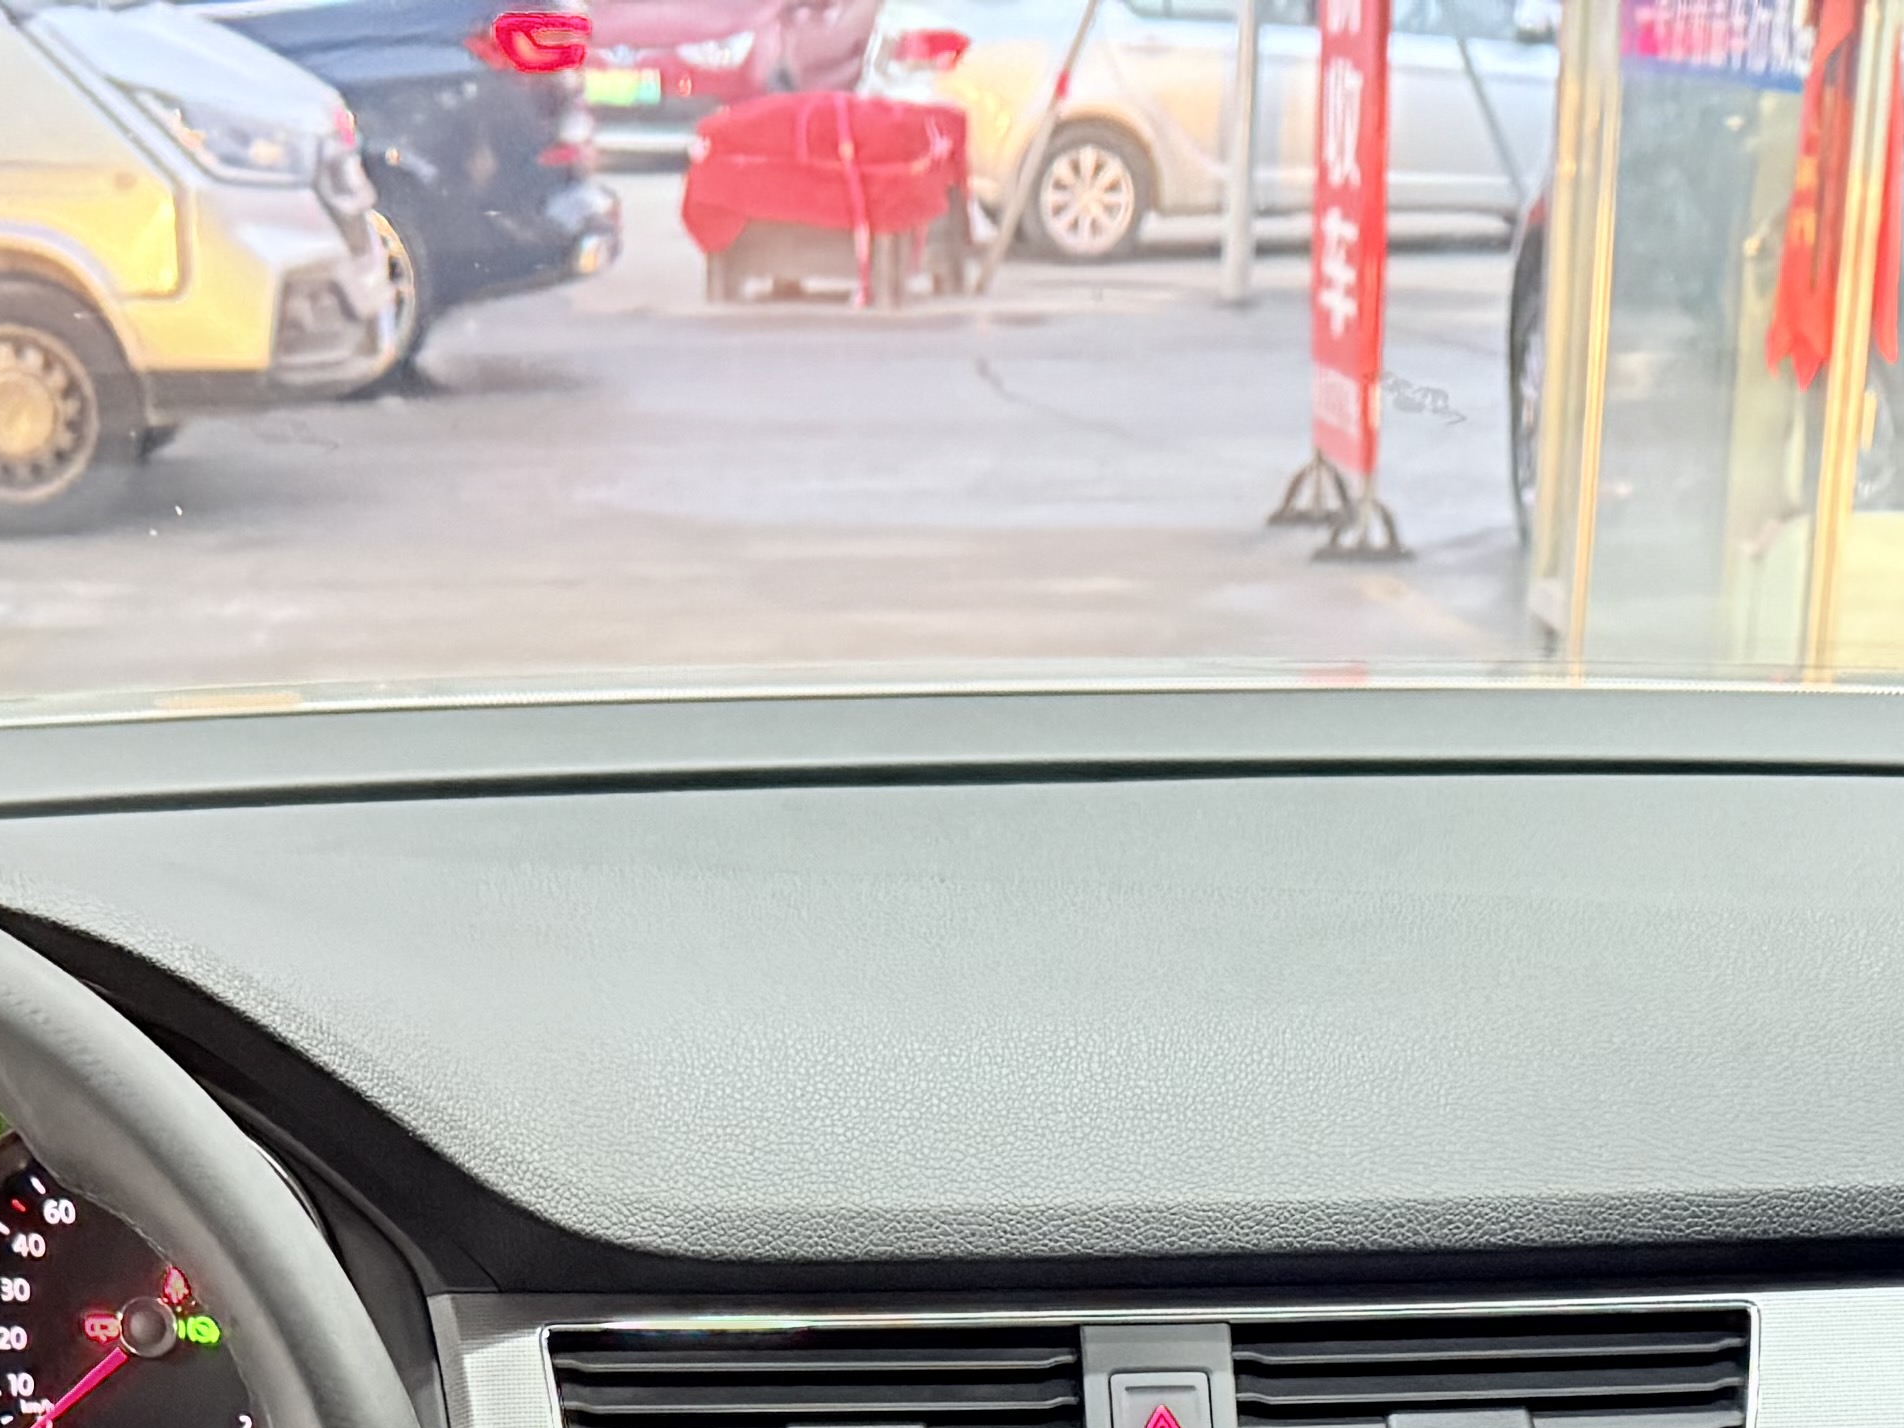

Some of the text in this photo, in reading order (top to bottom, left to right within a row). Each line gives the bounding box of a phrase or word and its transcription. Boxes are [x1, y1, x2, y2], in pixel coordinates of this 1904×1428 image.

[42, 1198, 77, 1225] 60
[11, 1232, 47, 1258] 40
[0, 1277, 31, 1302] 30
[6, 1372, 35, 1397] 10
